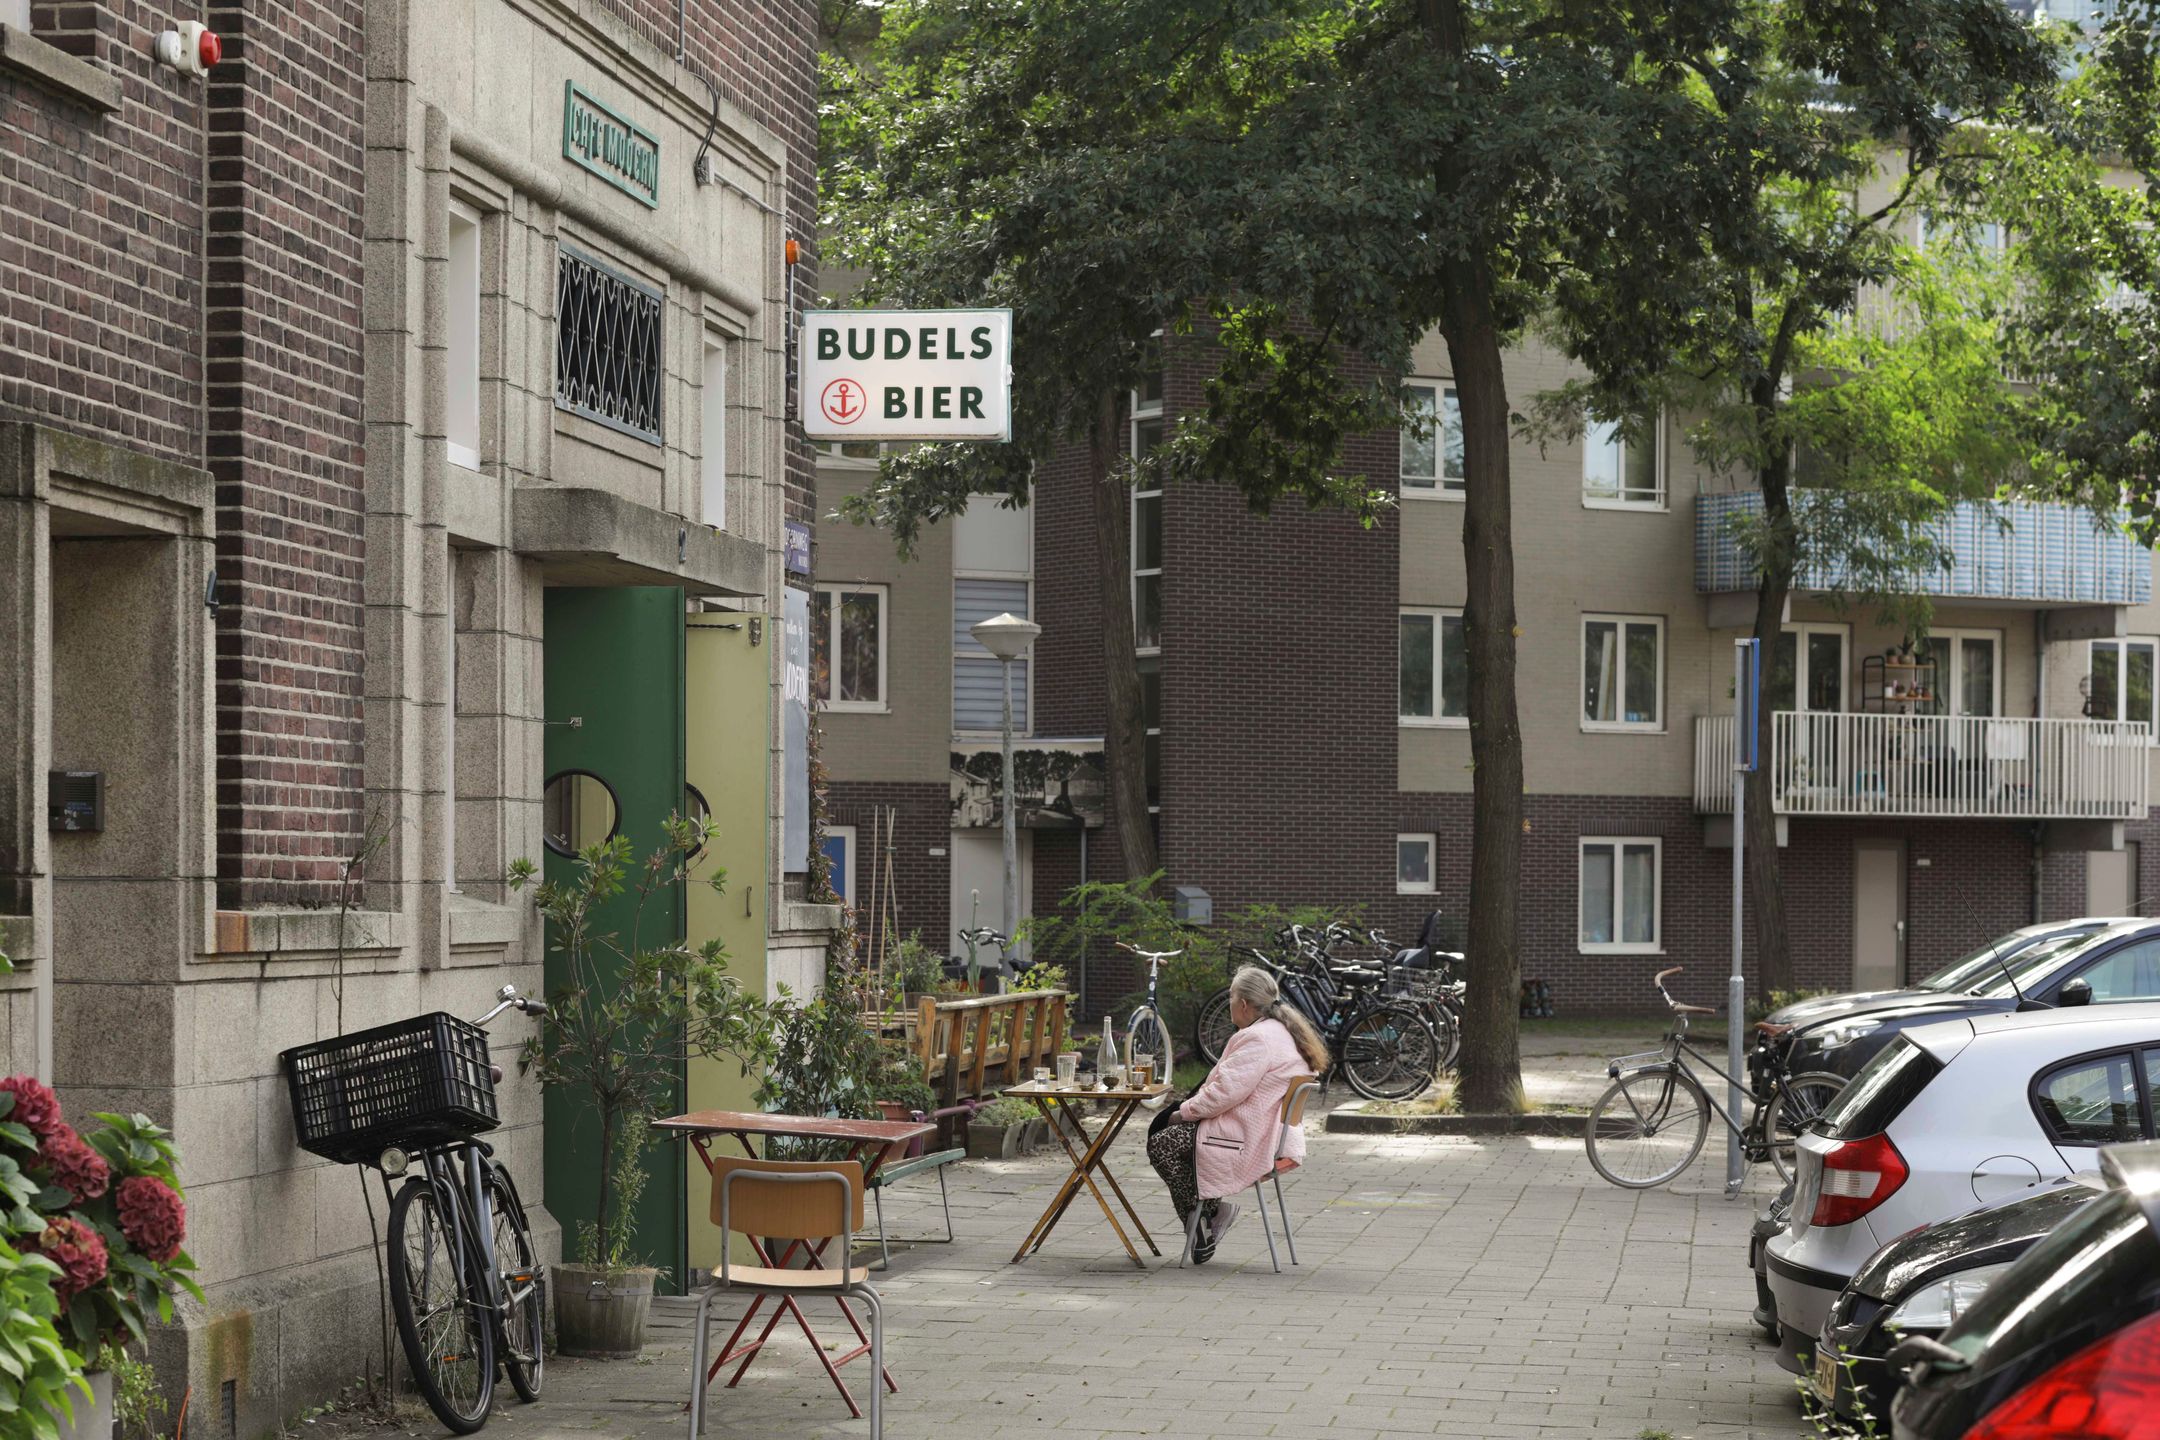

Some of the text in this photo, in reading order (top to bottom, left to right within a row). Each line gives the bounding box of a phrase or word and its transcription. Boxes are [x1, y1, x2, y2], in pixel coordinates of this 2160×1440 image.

[606, 123, 657, 191] MODERN
[817, 326, 993, 361] BUDELS
[883, 386, 986, 419] BIER
